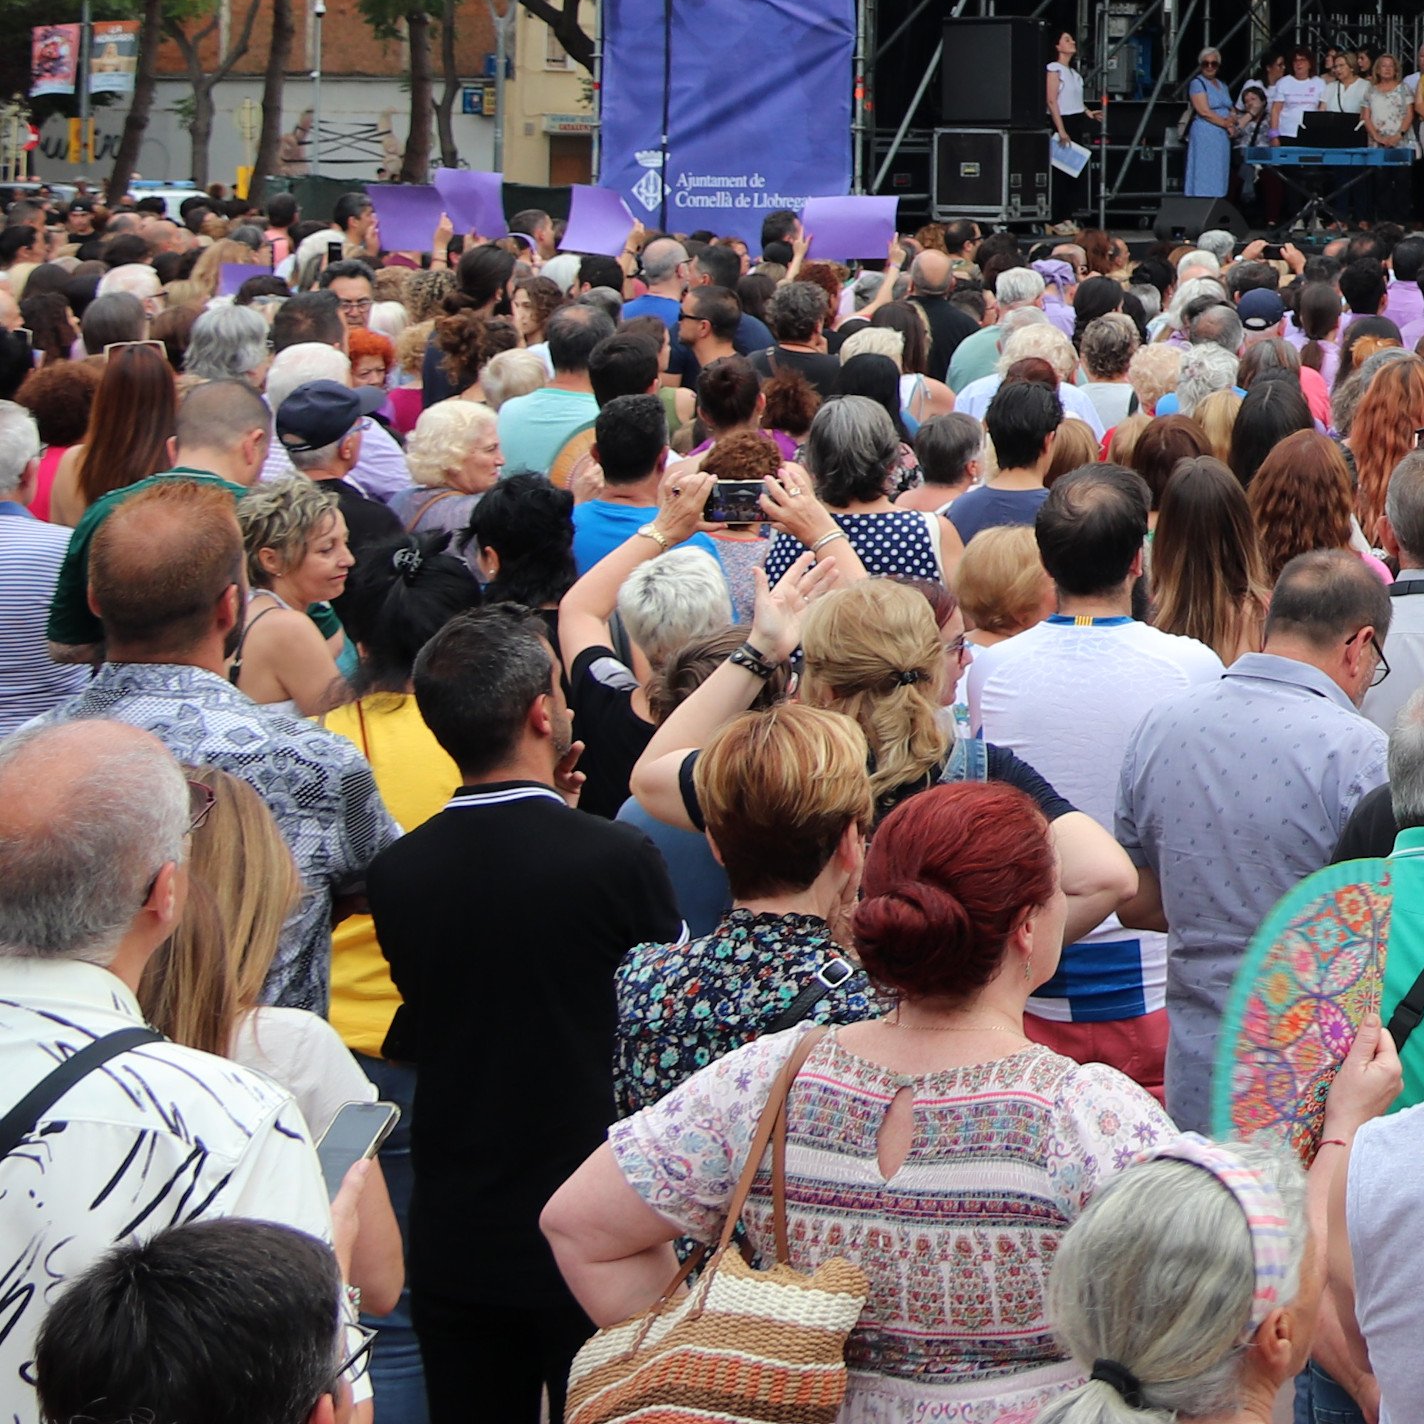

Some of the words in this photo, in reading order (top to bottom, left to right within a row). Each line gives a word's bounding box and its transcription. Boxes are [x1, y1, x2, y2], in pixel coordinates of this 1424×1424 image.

[675, 173, 748, 190] Ajuntament
[749, 174, 766, 188] de
[675, 191, 733, 208] Cornellà
[735, 193, 752, 208] de
[753, 192, 811, 212] Llobrega
